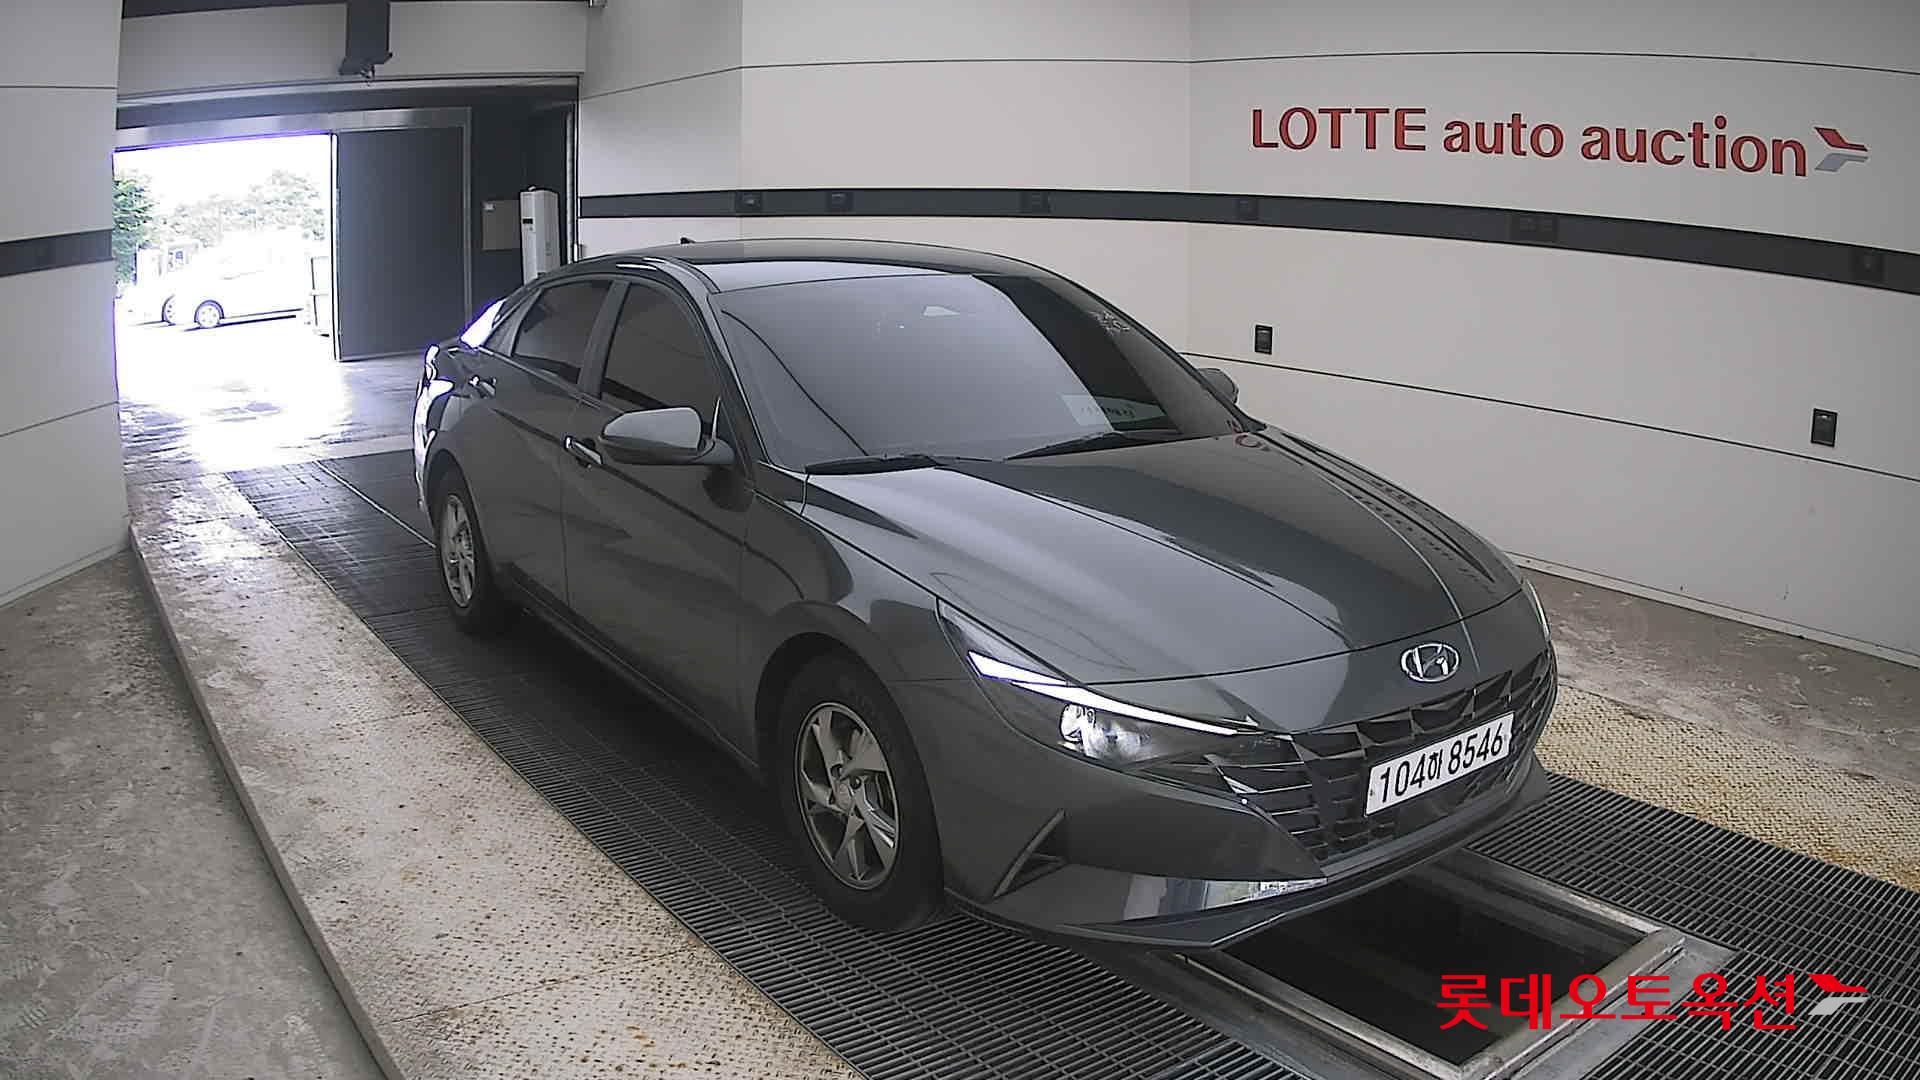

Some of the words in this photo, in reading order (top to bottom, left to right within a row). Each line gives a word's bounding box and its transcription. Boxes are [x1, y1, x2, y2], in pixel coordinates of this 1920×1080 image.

[1253, 107, 1427, 151] LOTTE
[1443, 113, 1565, 157] auto
[1580, 116, 1808, 177] auction
[1447, 722, 1503, 775] 8546
